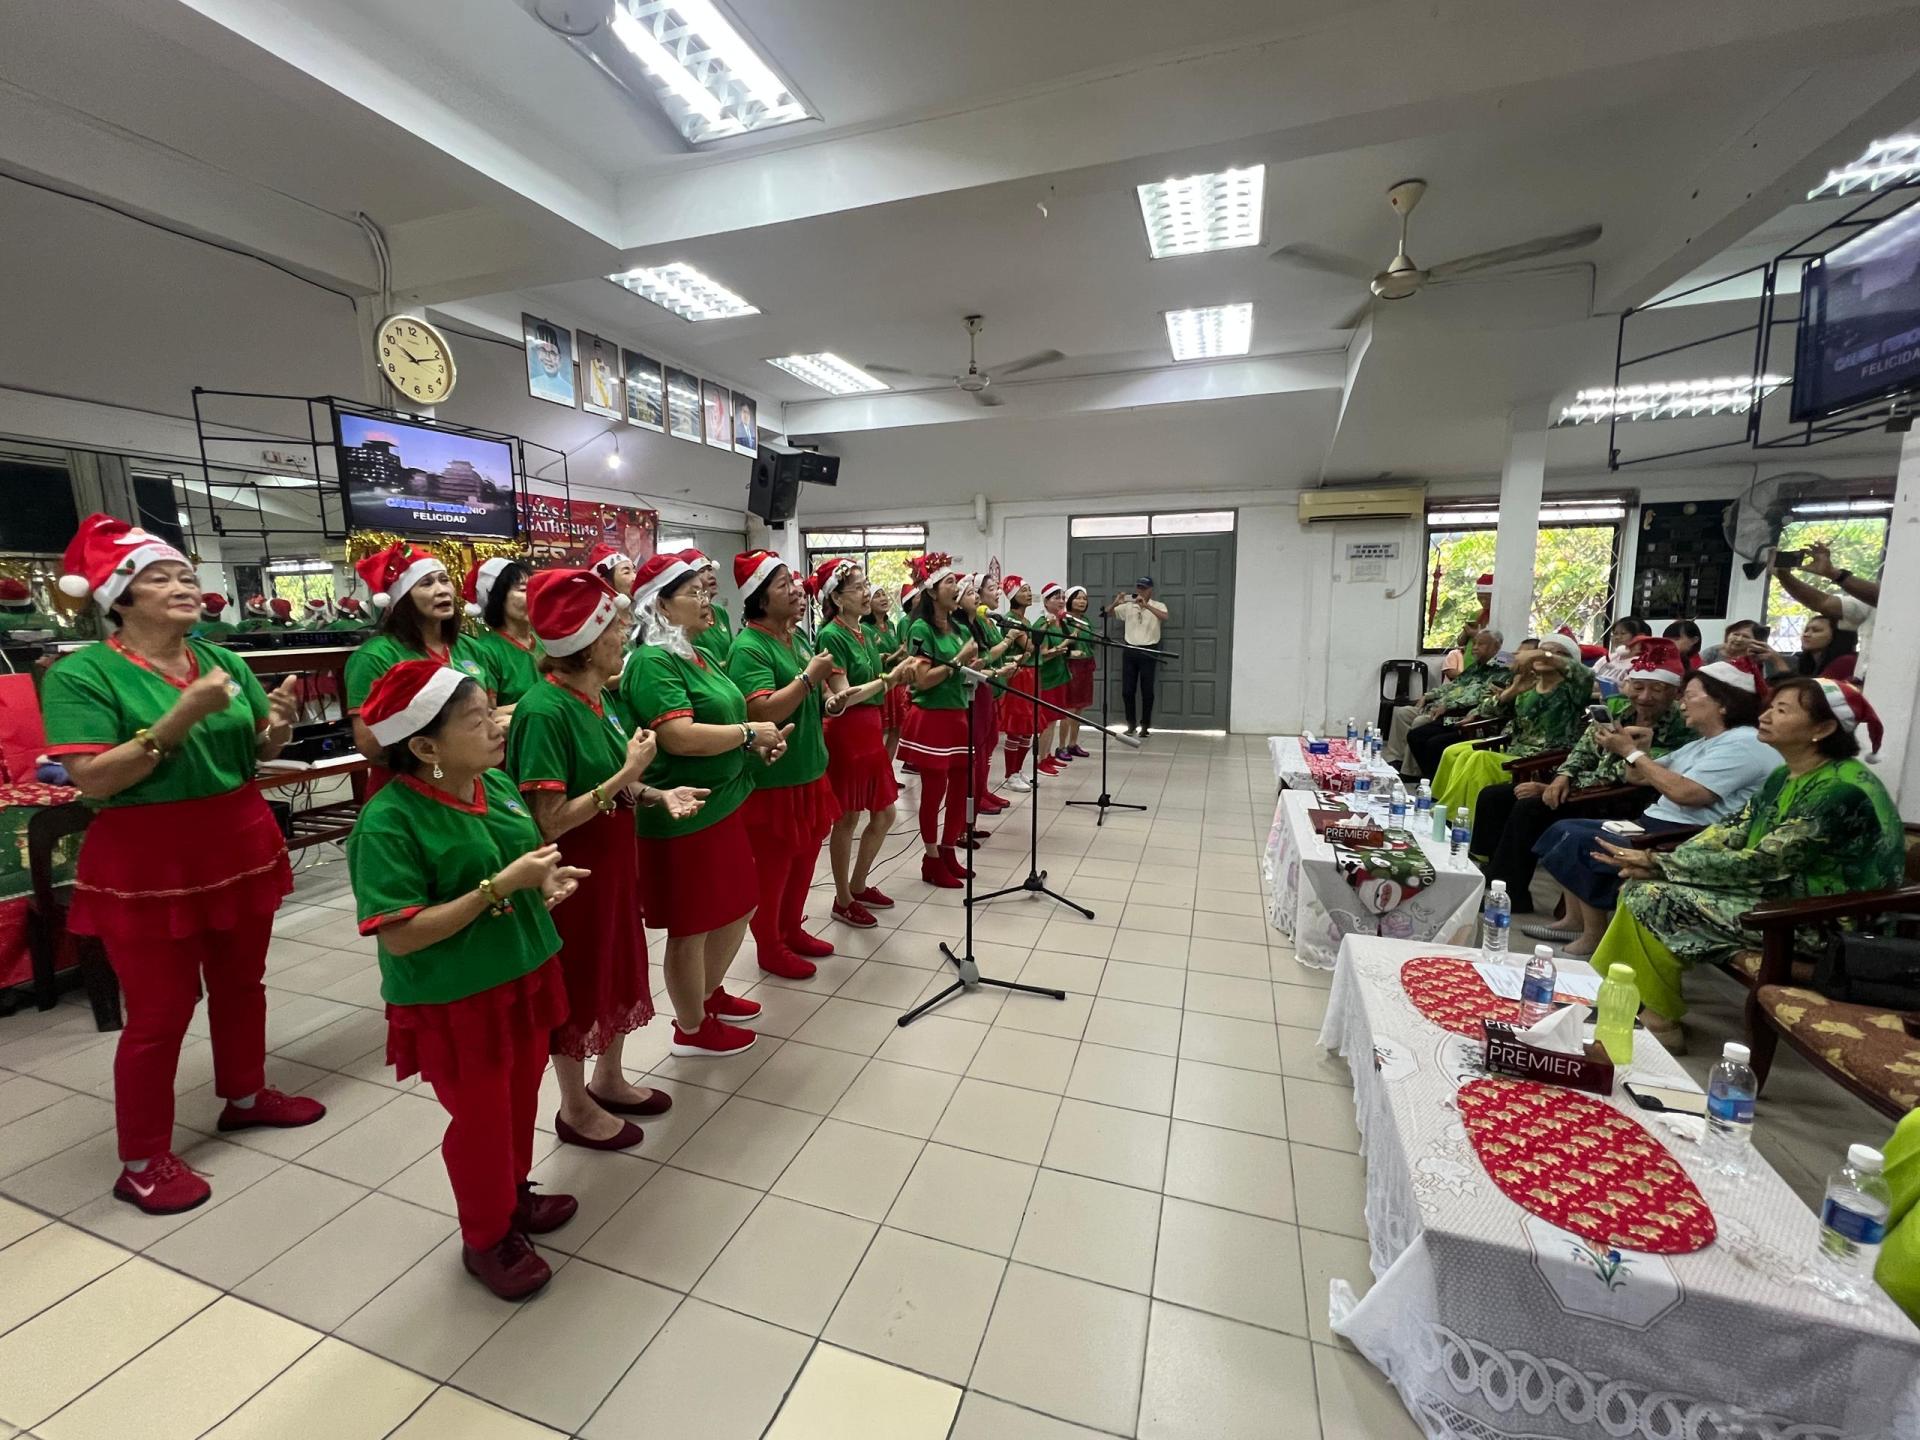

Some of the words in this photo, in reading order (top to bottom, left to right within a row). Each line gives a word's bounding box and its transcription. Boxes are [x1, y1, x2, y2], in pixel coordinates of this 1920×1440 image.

[396, 326, 403, 336] 11
[408, 326, 417, 337] 12
[386, 334, 396, 345] 10
[383, 347, 390, 357] 9
[434, 350, 440, 360] 2
[388, 363, 396, 373] 8
[438, 364, 444, 374] 3
[399, 376, 406, 386] 7
[435, 377, 442, 385] 4
[414, 385, 421, 394] 6
[427, 384, 434, 394] 5
[413, 511, 467, 523] FELICIDAD
[527, 519, 598, 536] GATHERING
[1325, 827, 1370, 840] PREMIER
[1489, 1045, 1580, 1078] PREMIER
